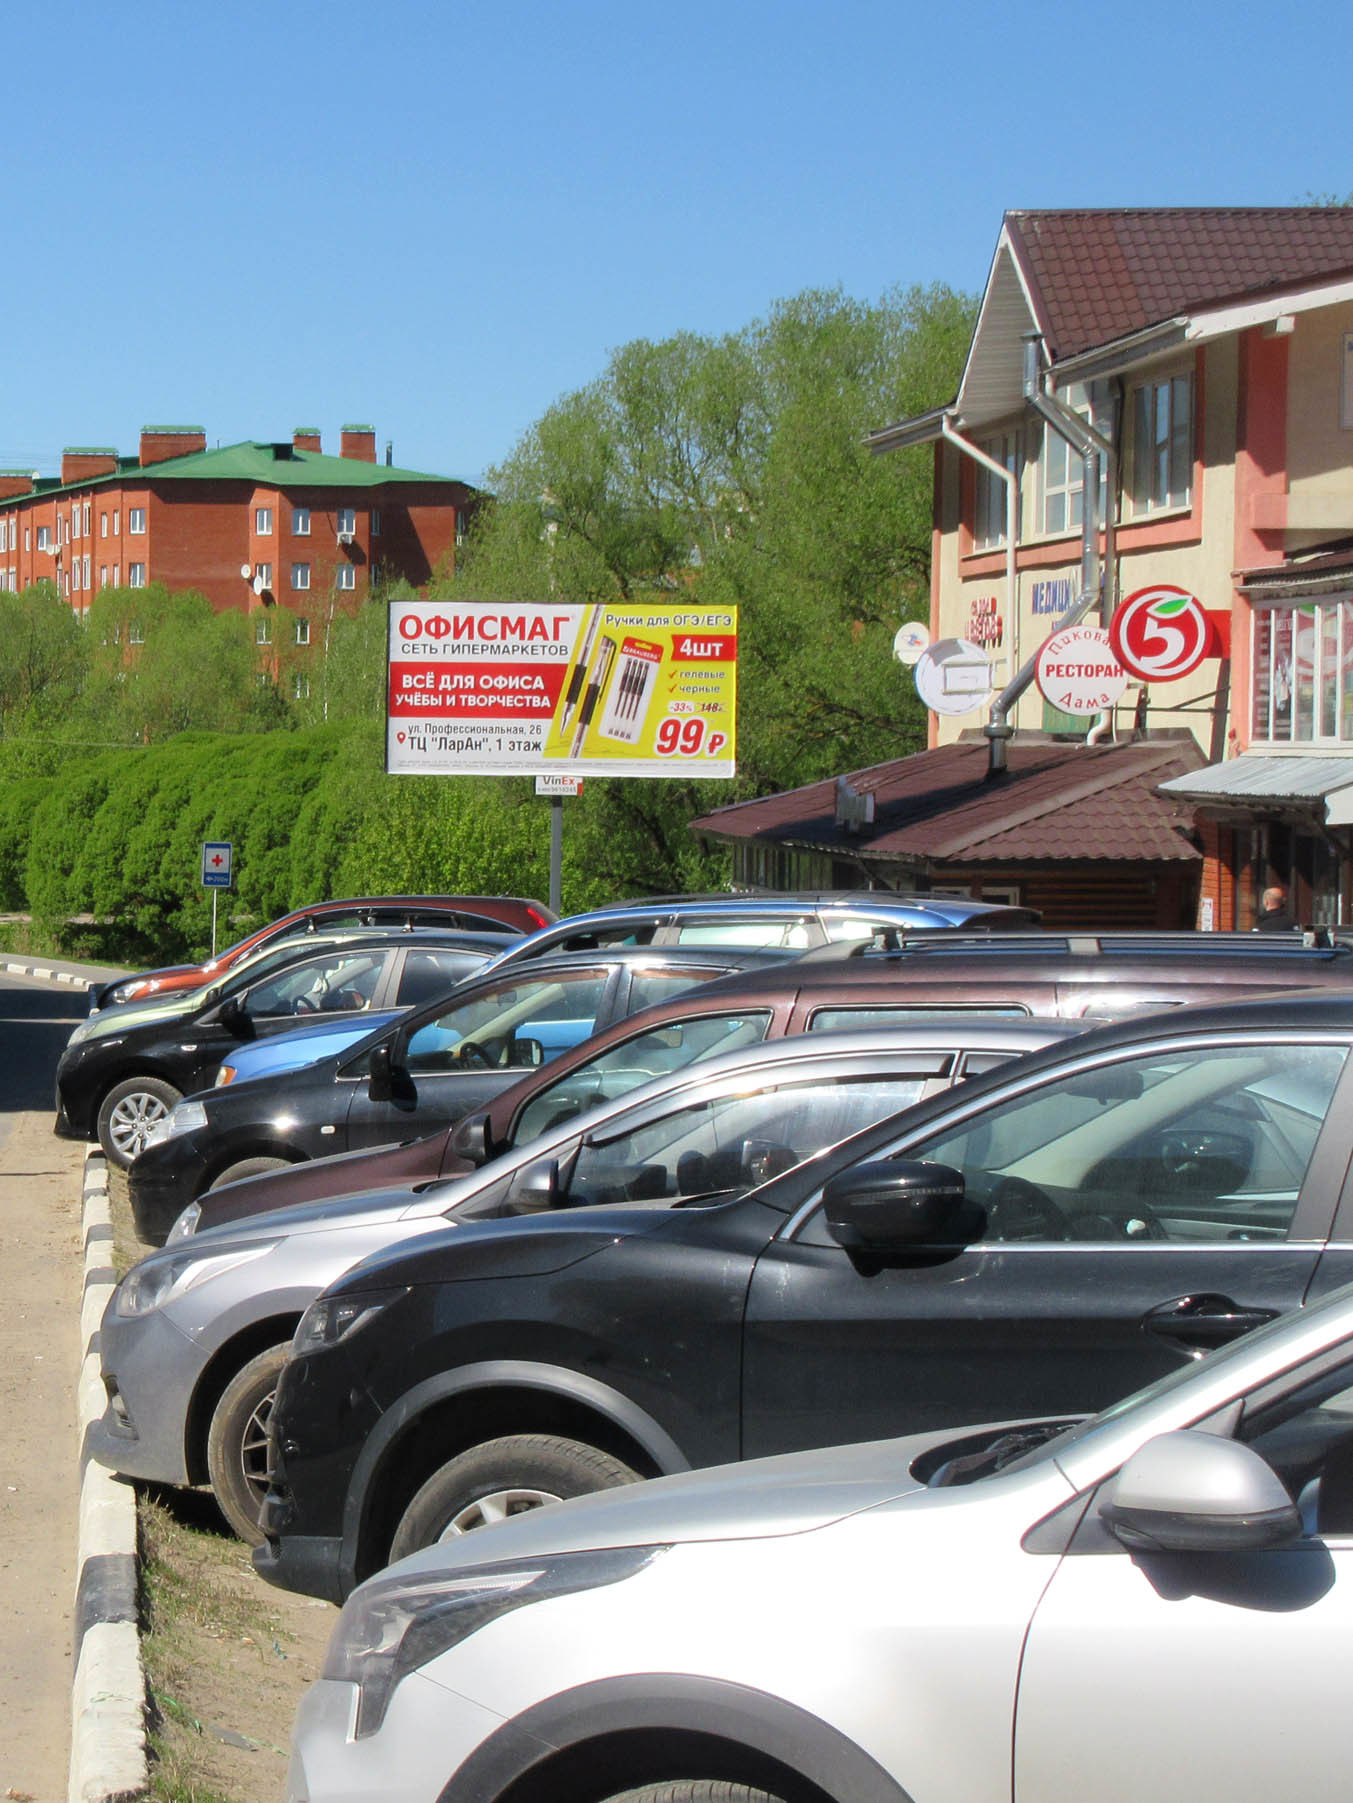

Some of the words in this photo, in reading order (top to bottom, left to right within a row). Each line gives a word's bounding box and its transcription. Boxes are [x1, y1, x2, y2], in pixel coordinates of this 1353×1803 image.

[399, 615, 570, 641] ОФИСМАГ
[605, 614, 643, 627] Ручки
[646, 617, 669, 627] для
[673, 615, 731, 626] ОГЭ/ЕГЭ
[401, 643, 438, 655] СЕТЬ
[443, 644, 568, 656] ГИПЕРМАРКЕТОВ
[679, 638, 724, 657] 4шт
[1048, 630, 1113, 656] Пикова
[679, 669, 725, 679] гелевые
[1045, 664, 1124, 678] РЕСТОРАН
[402, 671, 435, 689] ВСЁ
[439, 674, 475, 691] ДЛЯ
[479, 674, 545, 691] ОФИСА
[679, 684, 720, 696] черные
[395, 691, 443, 706] УЧЁБЫ
[446, 694, 456, 706] И
[459, 694, 551, 708] ТВОРЧЕСТВА
[1058, 691, 1110, 710] Дама
[407, 724, 422, 736] ул.
[424, 722, 527, 738] Профессиональная,
[529, 724, 542, 735] 26
[656, 718, 705, 755] 99
[408, 736, 427, 752] ТЦ
[496, 739, 503, 751] 1
[508, 740, 542, 752] этаж
[543, 775, 575, 785] VinEx
